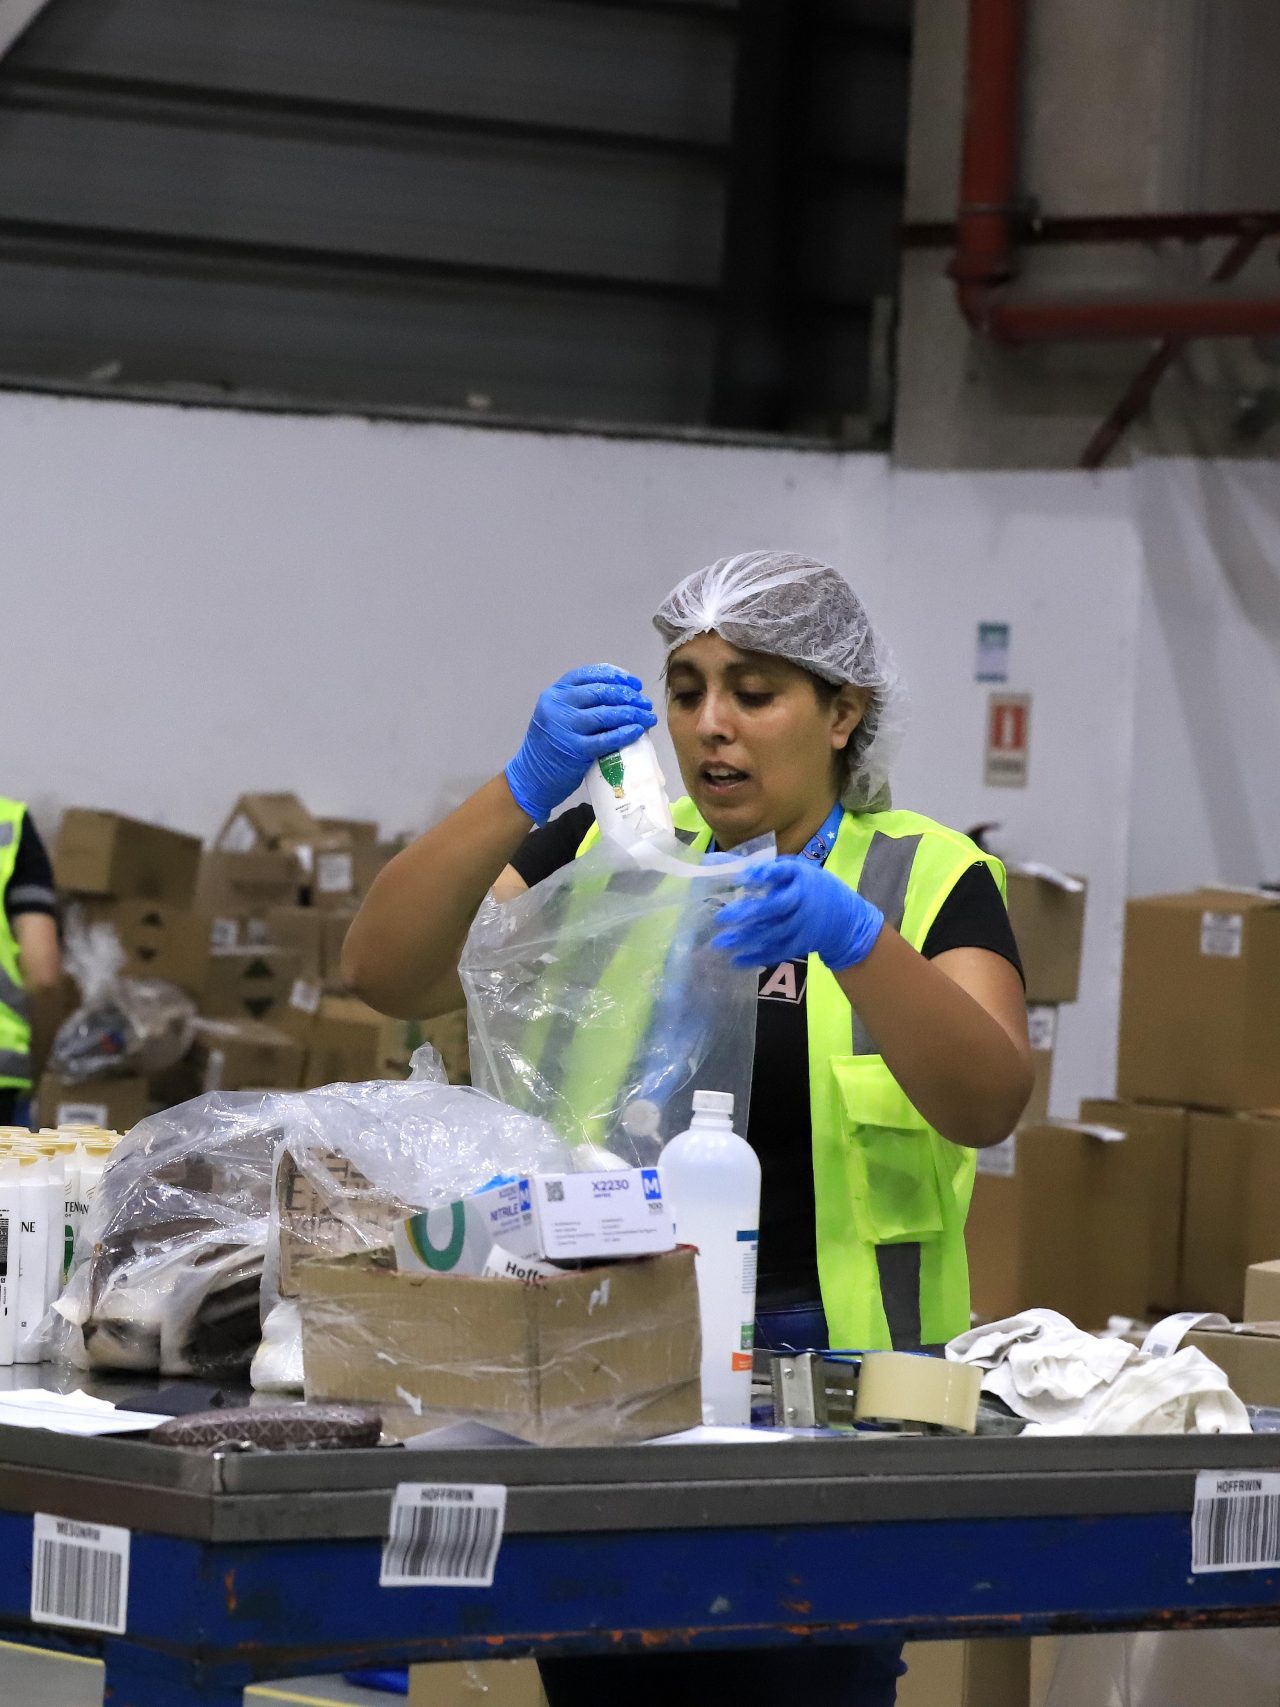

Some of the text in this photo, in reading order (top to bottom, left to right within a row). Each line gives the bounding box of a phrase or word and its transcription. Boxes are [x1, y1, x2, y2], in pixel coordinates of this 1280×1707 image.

[591, 1177, 660, 1195] X2230 M
[490, 1203, 519, 1222] NITRILE
[21, 1221, 36, 1233] NE
[1216, 1479, 1262, 1494] HOFFRWIN
